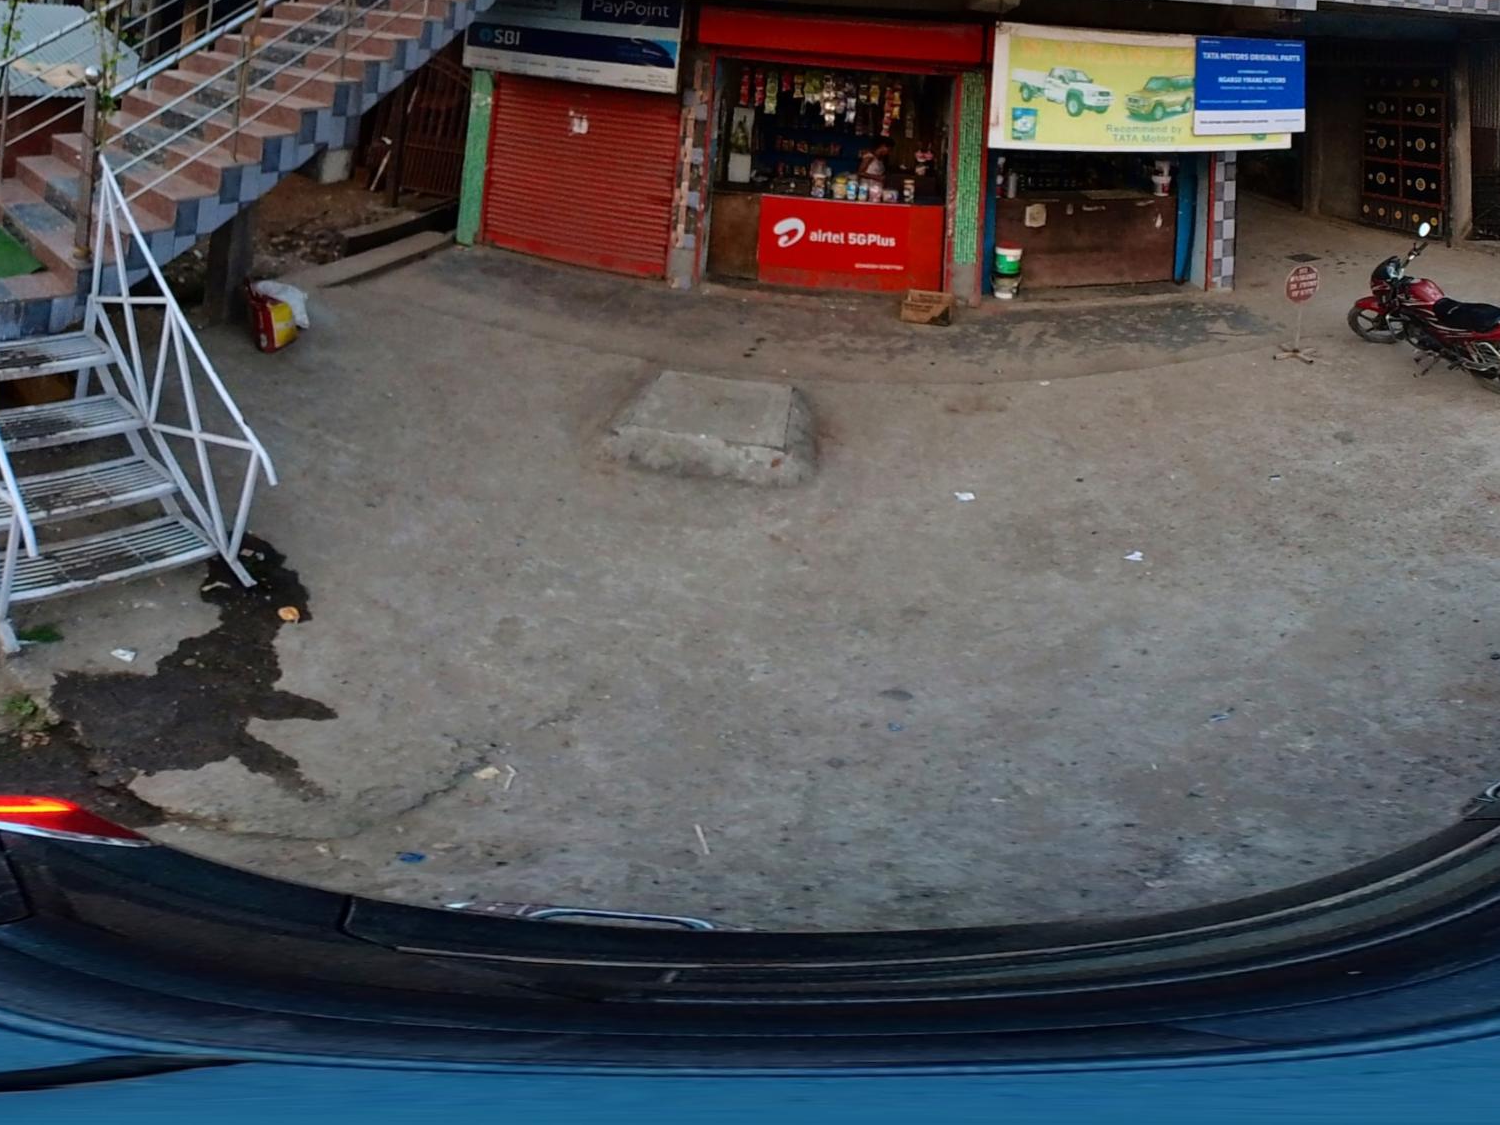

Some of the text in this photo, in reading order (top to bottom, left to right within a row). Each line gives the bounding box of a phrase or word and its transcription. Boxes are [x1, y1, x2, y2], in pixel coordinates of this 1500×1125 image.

[493, 29, 520, 46] SBI
[1171, 125, 1182, 135] by
[1112, 134, 1175, 143] TATA Motors
[809, 229, 845, 244] airtel
